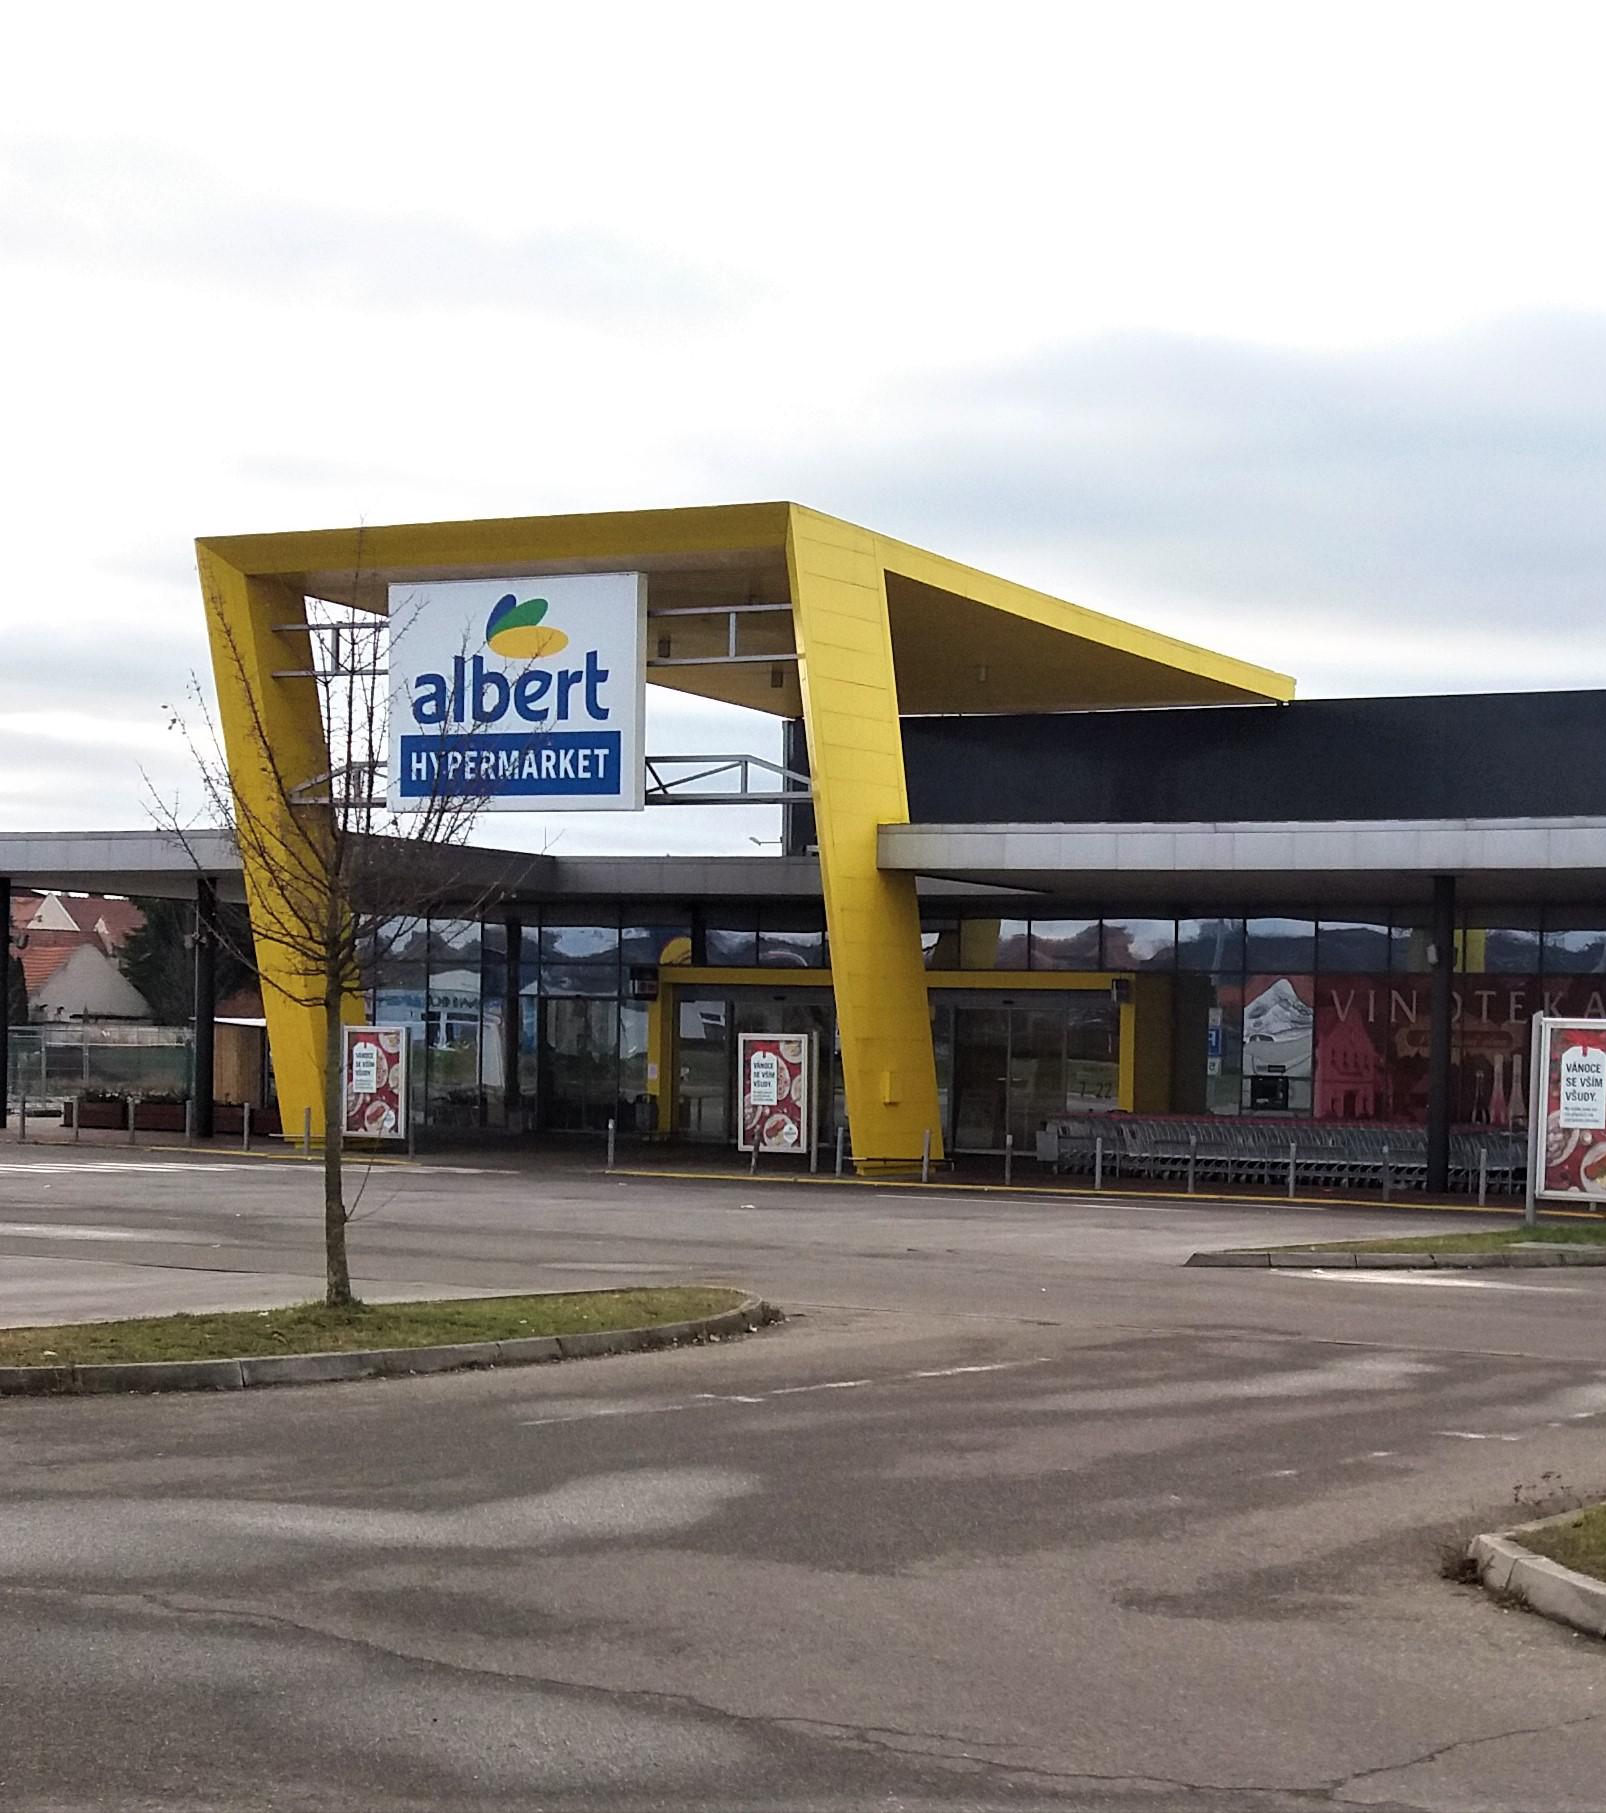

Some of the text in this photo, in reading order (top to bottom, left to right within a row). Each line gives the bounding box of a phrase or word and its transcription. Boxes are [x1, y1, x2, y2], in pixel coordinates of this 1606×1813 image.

[412, 650, 610, 725] albert
[411, 748, 610, 782] HYPERMARKET
[1565, 1062, 1601, 1074] VÁNOCE
[1565, 1076, 1603, 1088] SE VŠÍM
